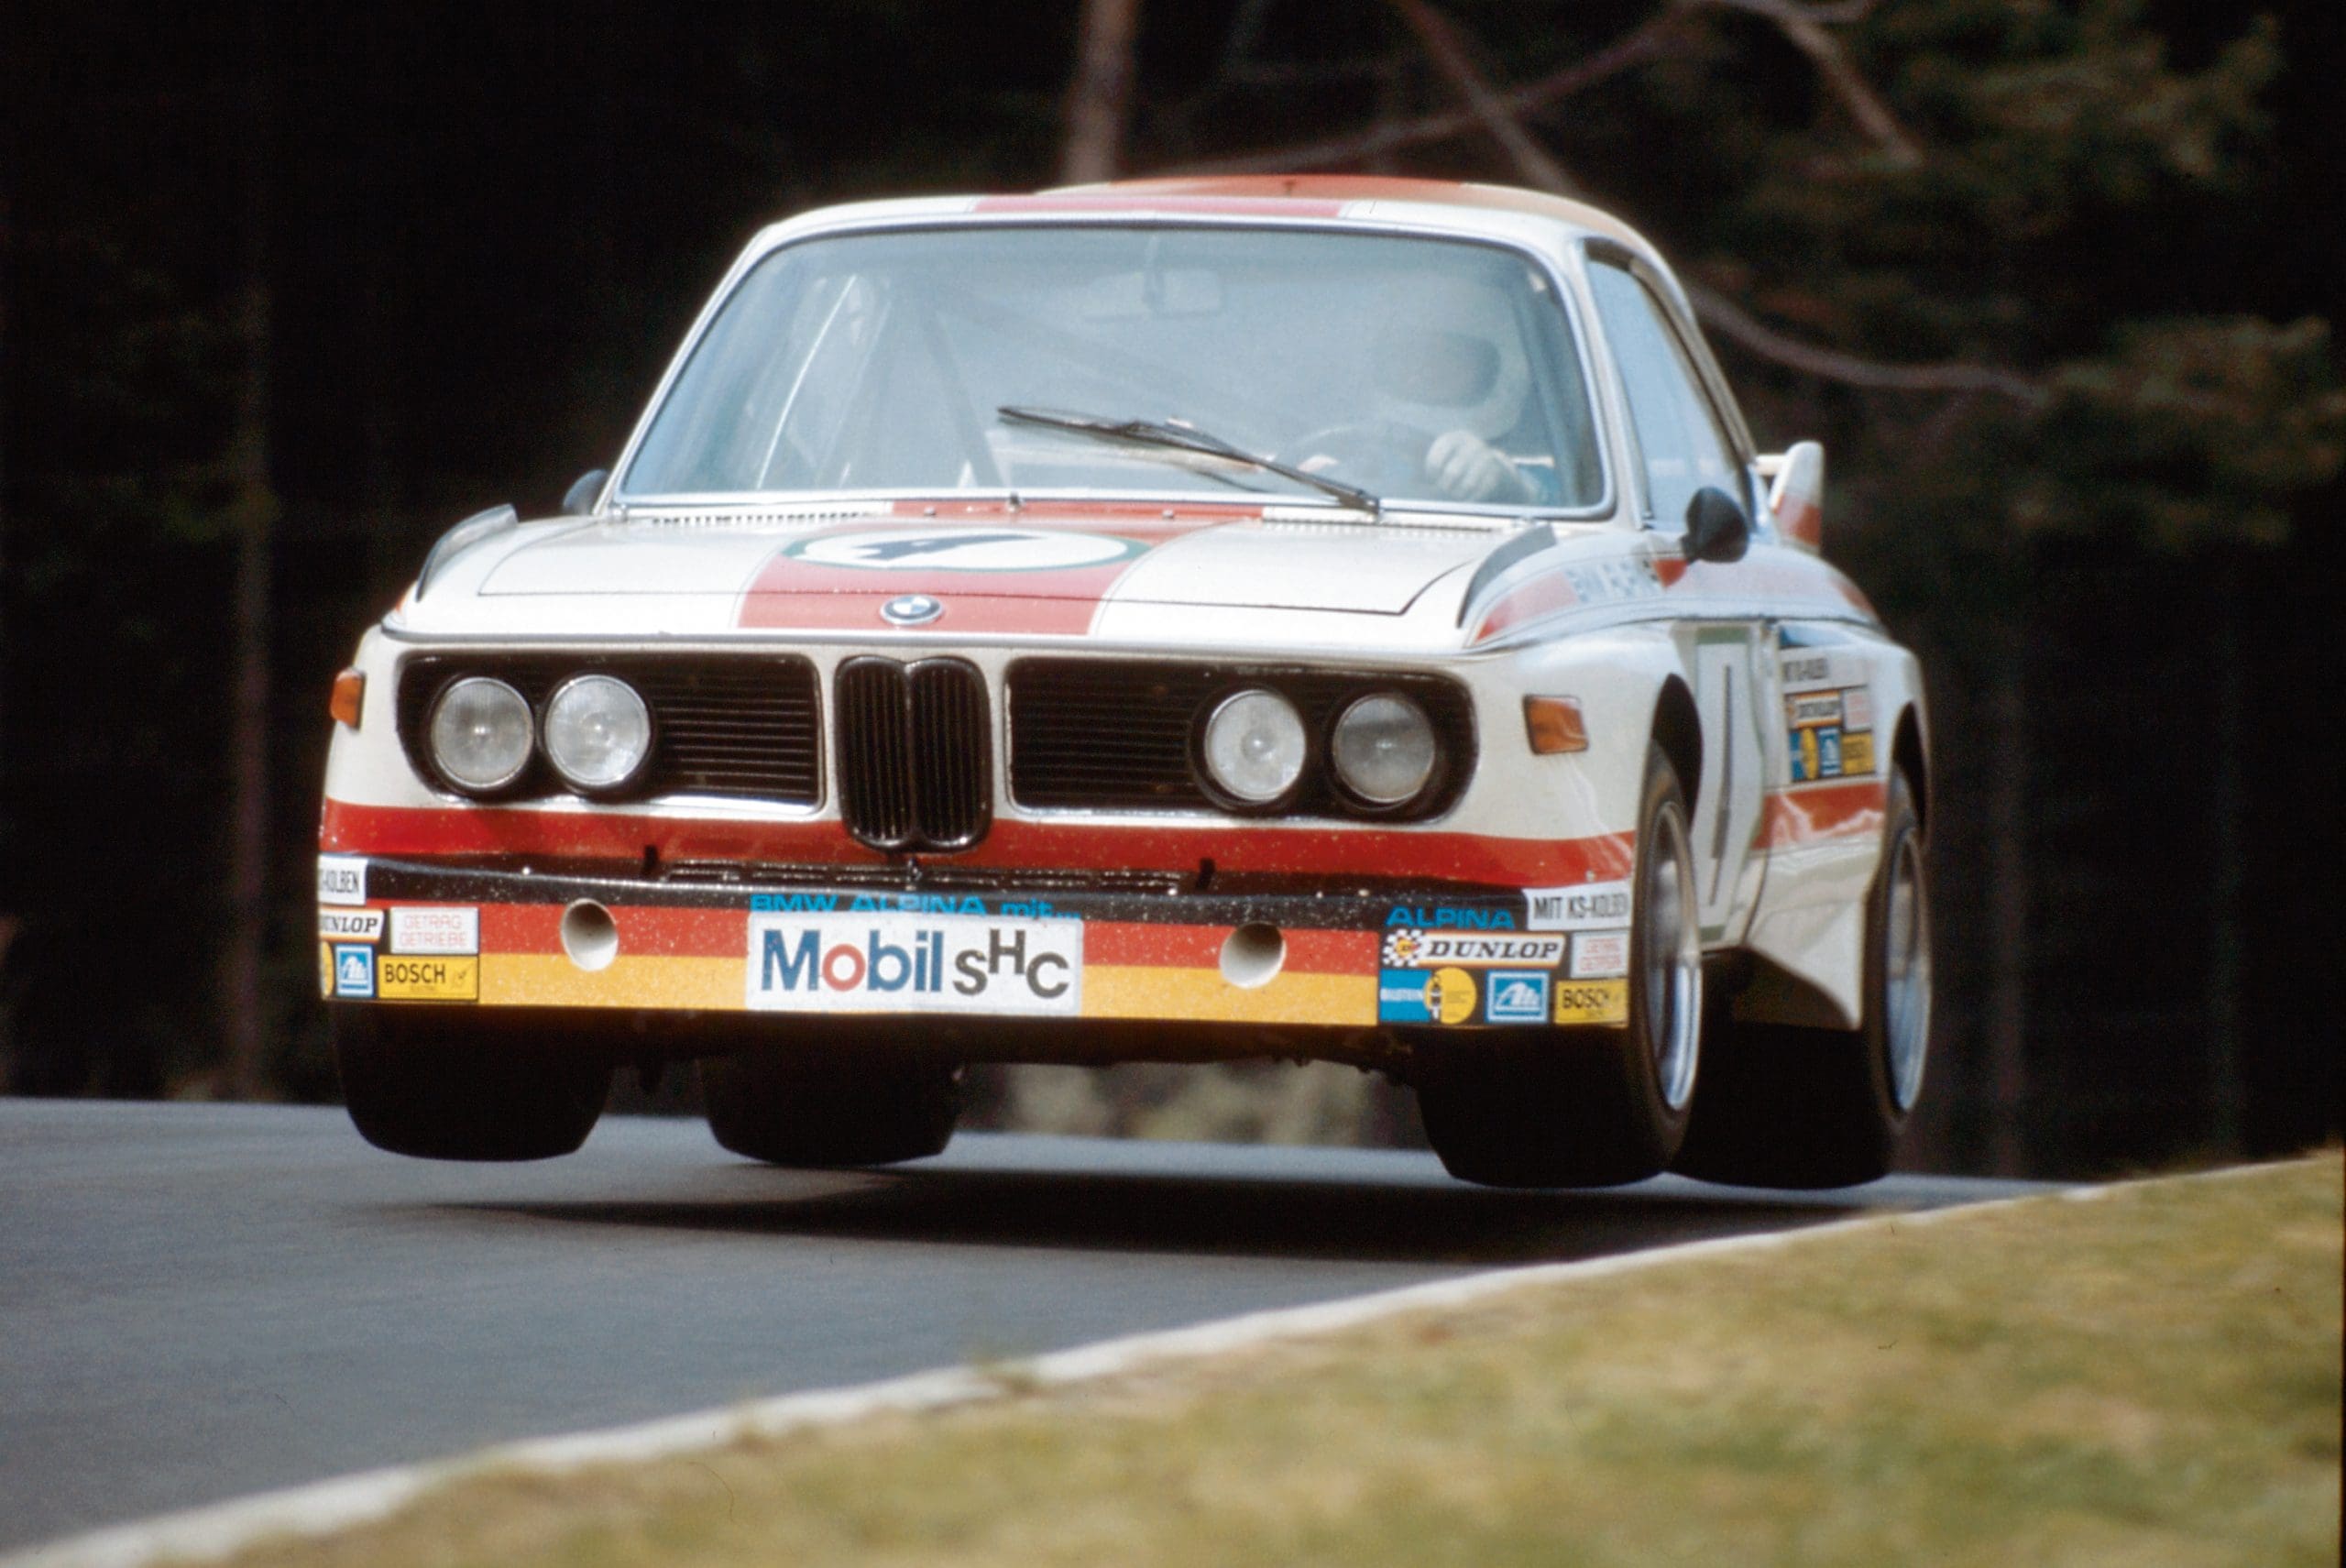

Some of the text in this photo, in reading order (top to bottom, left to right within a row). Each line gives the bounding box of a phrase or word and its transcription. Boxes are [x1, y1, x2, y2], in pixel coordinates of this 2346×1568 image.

[750, 894, 837, 912] BMW
[850, 894, 988, 916] ALPINA
[1533, 895, 1563, 920] MIT
[1385, 905, 1516, 930] ALPINA
[1427, 939, 1559, 959] DUNLOP
[384, 963, 446, 984] BOSCH
[761, 927, 1070, 1000] Mobil SHC
